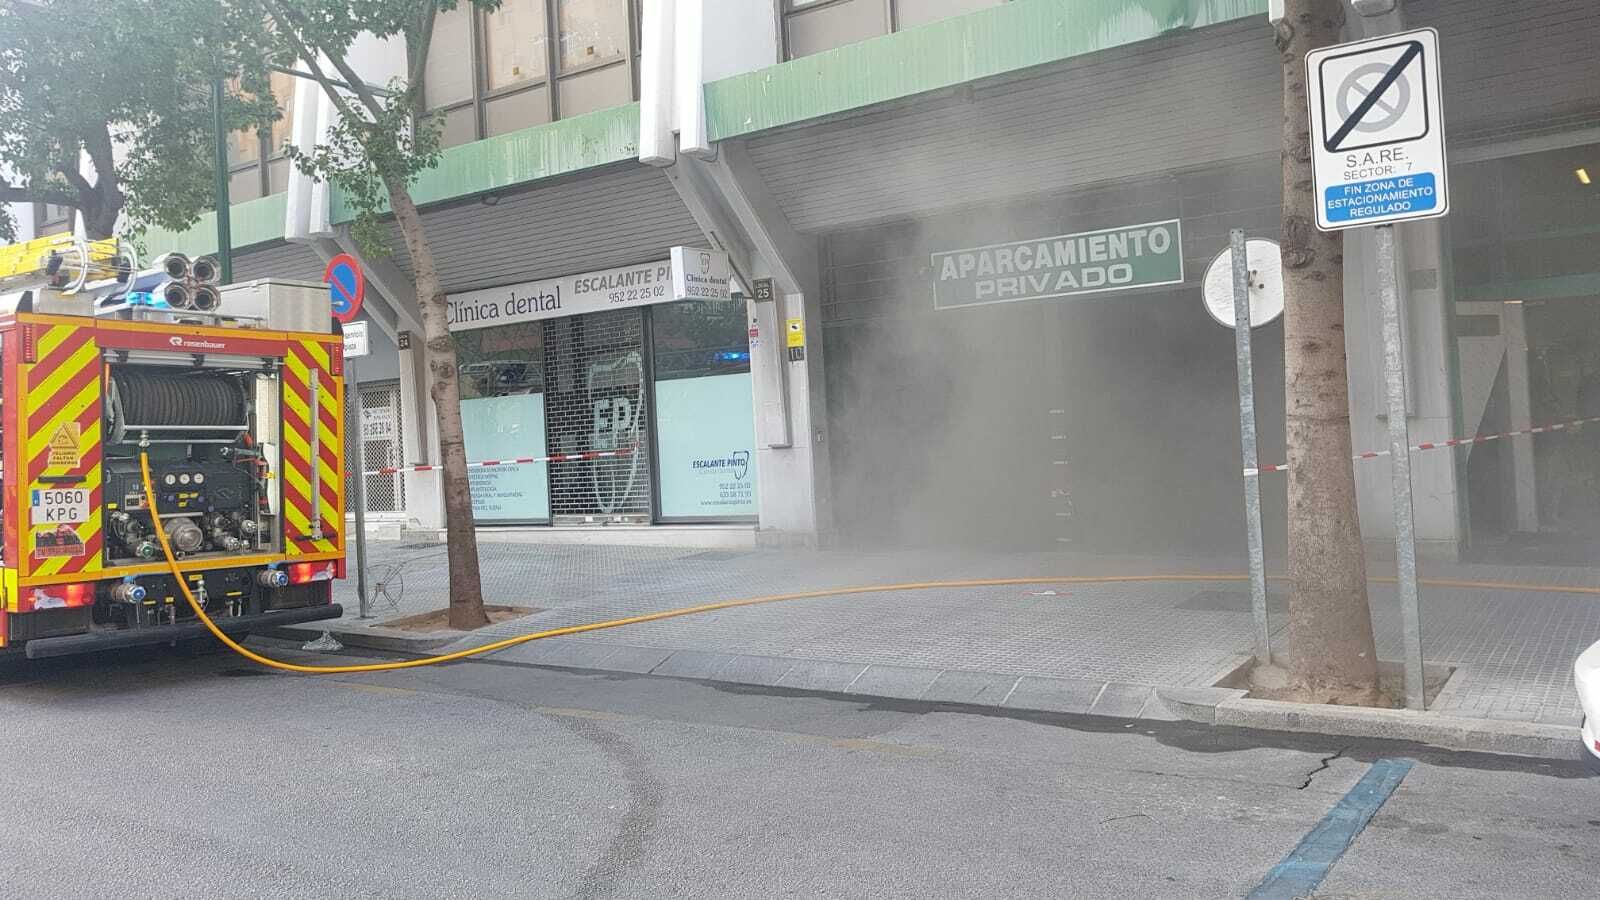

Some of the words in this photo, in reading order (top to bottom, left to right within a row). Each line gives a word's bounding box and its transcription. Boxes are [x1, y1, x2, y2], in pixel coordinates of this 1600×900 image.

[1407, 161, 1413, 171] 7
[1344, 185, 1362, 196] FIN
[1364, 181, 1396, 193] ZONA
[1398, 177, 1414, 188] DE
[1327, 186, 1433, 209] ESTACIONAMIENTO
[1350, 201, 1411, 217] REGULADO
[940, 226, 1172, 281] APARCAMIENTO
[574, 268, 652, 294] ESCALANTE
[656, 266, 673, 282] PI
[975, 263, 1133, 299] PRIVADO
[505, 285, 563, 316] dental
[609, 291, 625, 303] 952
[626, 289, 638, 300] 22
[640, 288, 651, 299] 25
[653, 285, 664, 297] 02
[757, 288, 769, 299] 25
[692, 459, 726, 469] ESCALANTE
[727, 458, 746, 467] PINTO
[44, 490, 83, 505] 5060
[46, 507, 78, 521] KPG
